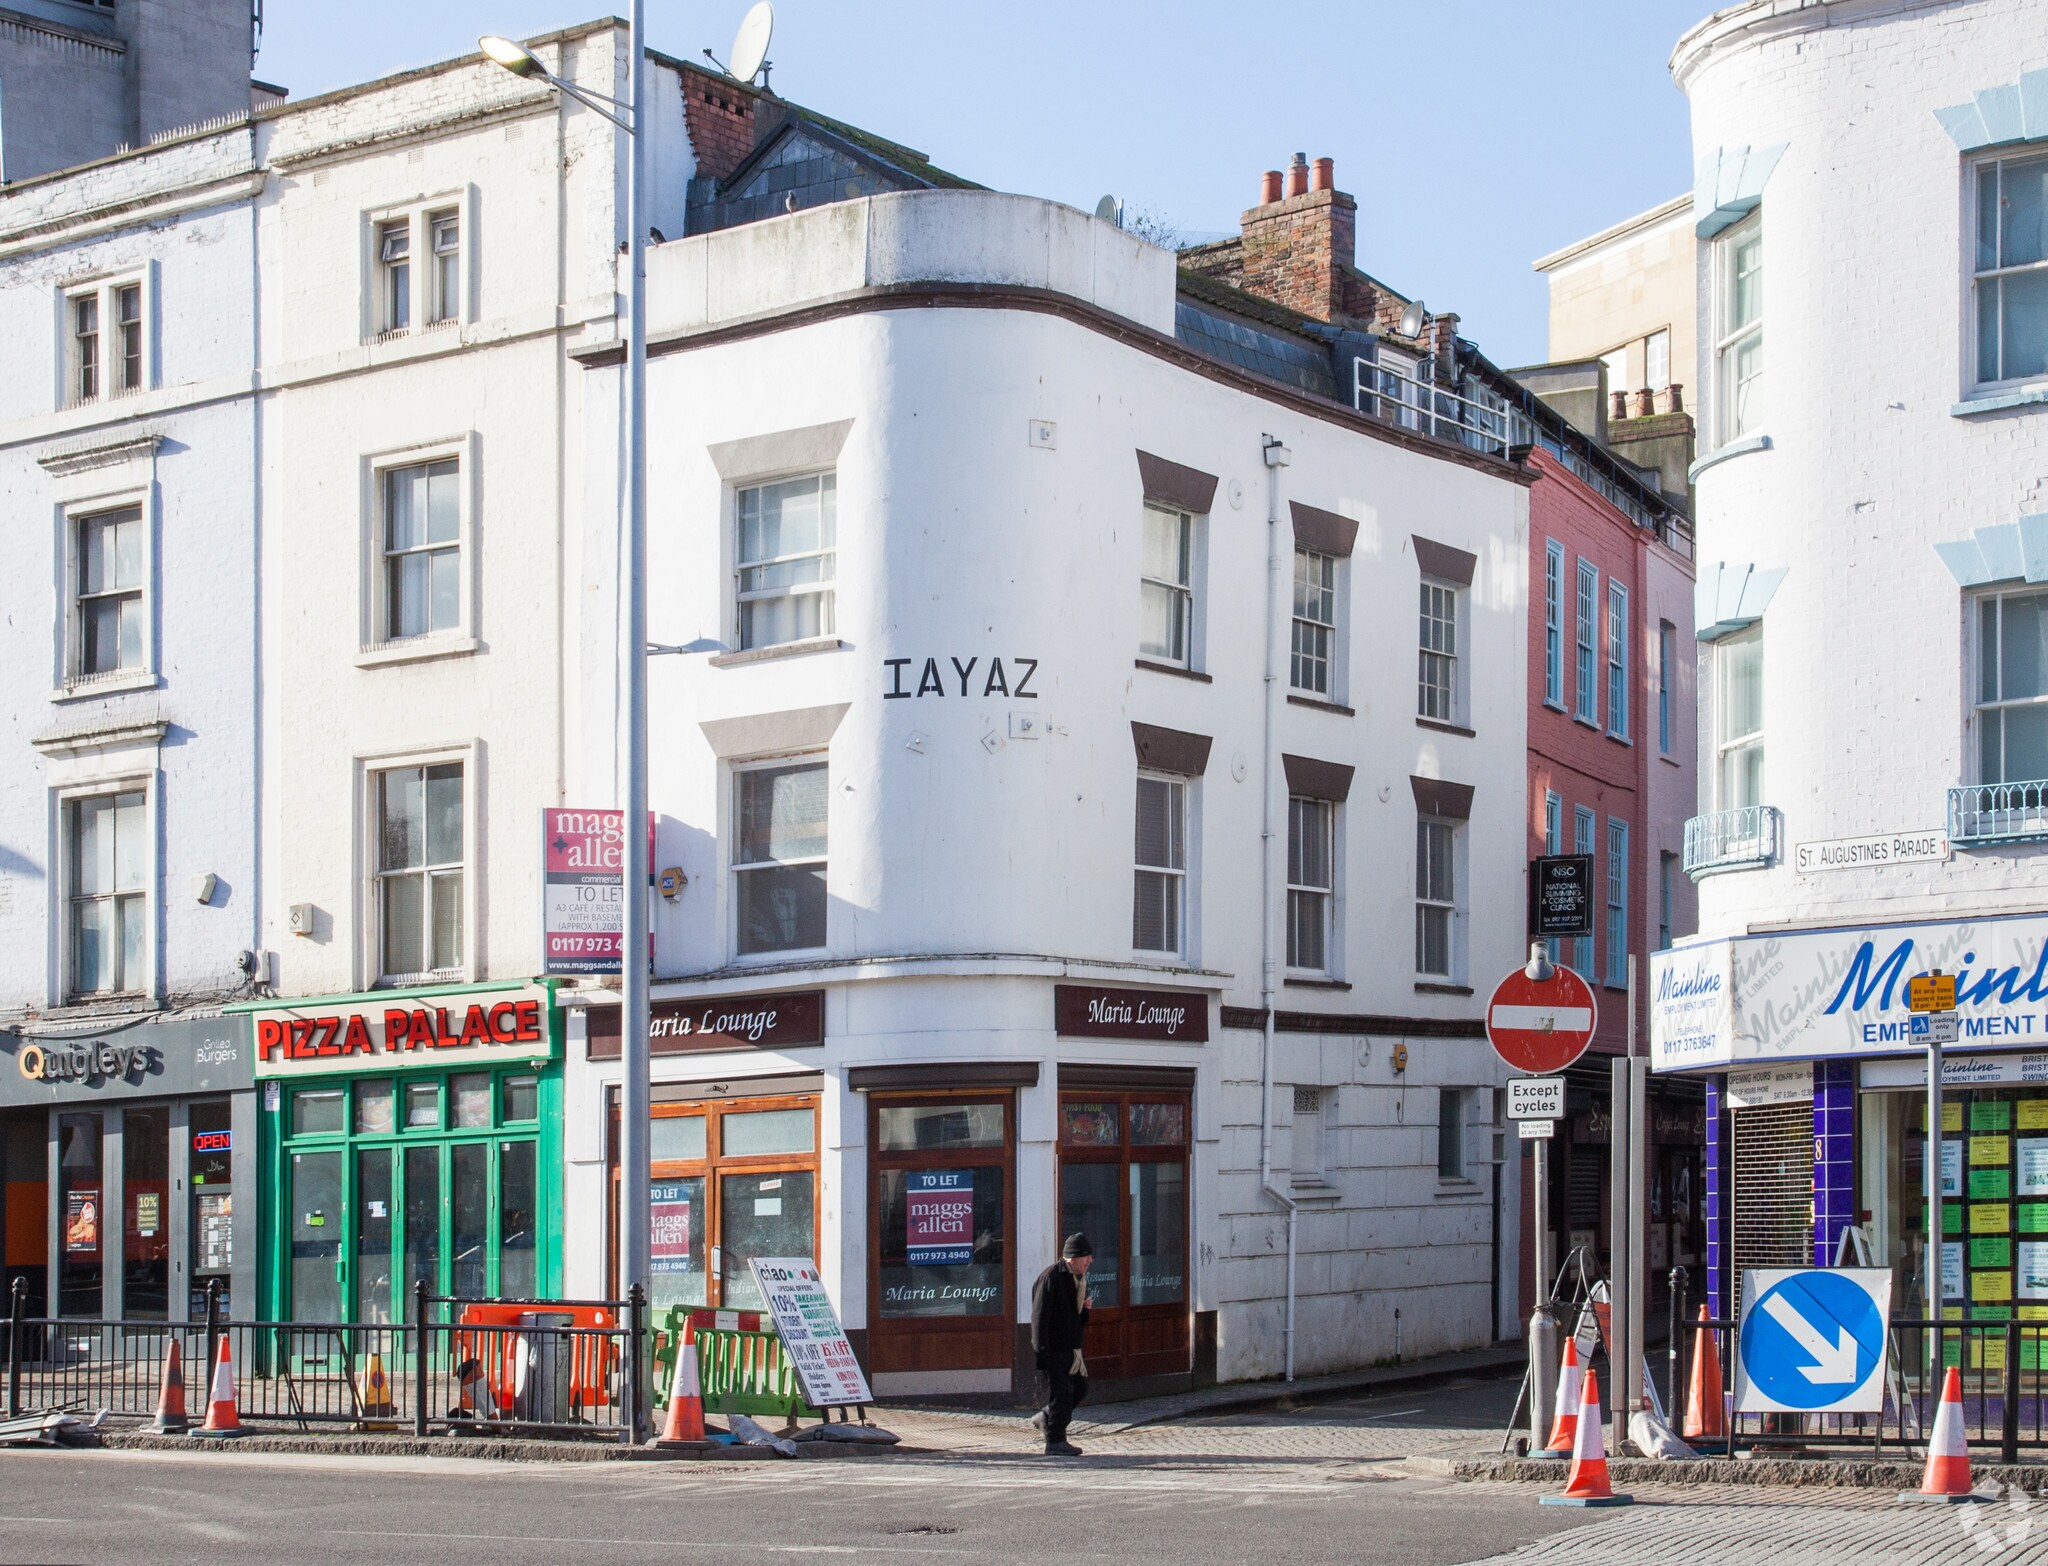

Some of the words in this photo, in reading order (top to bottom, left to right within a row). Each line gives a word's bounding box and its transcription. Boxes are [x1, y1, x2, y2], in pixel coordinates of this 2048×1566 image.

[884, 657, 1038, 699] IAYAZ
[556, 813, 624, 843] mag
[1821, 843, 1888, 864] AUGUSTINES
[1894, 838, 1936, 858] PARADE
[581, 875, 622, 883] commercial
[575, 886, 596, 901] TO
[1546, 890, 1581, 898] SLIMMING
[1549, 896, 1584, 904] COSMETIC
[556, 904, 567, 912] A3
[568, 913, 589, 921] WITH
[558, 922, 593, 931] (APPROX
[595, 923, 617, 931] 1,200
[552, 937, 583, 951] 0117
[586, 937, 612, 951] 973
[548, 961, 624, 971] www.maggsandalle
[1658, 962, 1721, 1002] Mainline
[1665, 999, 1697, 1015] EMPLOYMENT
[1698, 998, 1716, 1009] LIMITED
[1088, 996, 1133, 1024] Maria
[1135, 1001, 1185, 1034] Lounge
[258, 1018, 372, 1061] PIZZA
[384, 1000, 540, 1051] PALACE
[649, 1009, 693, 1037] aria
[697, 1008, 778, 1041] Lounge
[1664, 1040, 1681, 1054] 0117
[1684, 1034, 1716, 1051] 3763647
[19, 1040, 149, 1085] Quigleys
[197, 1048, 237, 1066] Burgers
[1729, 1073, 1752, 1085] OPENING
[1753, 1071, 1771, 1081] HOURS
[1513, 1084, 1559, 1098] Except
[1757, 1085, 1769, 1093] PHONE
[1515, 1100, 1556, 1114] cycles
[1531, 1121, 1551, 1129] loading
[193, 1134, 230, 1149] OPEN
[1815, 1139, 1822, 1160] 8
[922, 1176, 936, 1186] TO
[940, 1175, 958, 1185] LET
[664, 1189, 678, 1199] LET
[139, 1196, 157, 1208] 10%
[911, 1202, 972, 1219] maggs
[918, 1216, 964, 1233] allen
[931, 1252, 946, 1260] 973
[948, 1251, 970, 1259] 4940
[760, 1264, 787, 1281] ciao
[1086, 1271, 1117, 1285] Restaurant
[1129, 1275, 1154, 1289] Maria
[1154, 1273, 1182, 1290] Lounge
[886, 1285, 936, 1301] Maria
[940, 1285, 997, 1302] Lounge
[771, 1294, 798, 1313] 10%
[794, 1293, 827, 1304] TAKEAWAY
